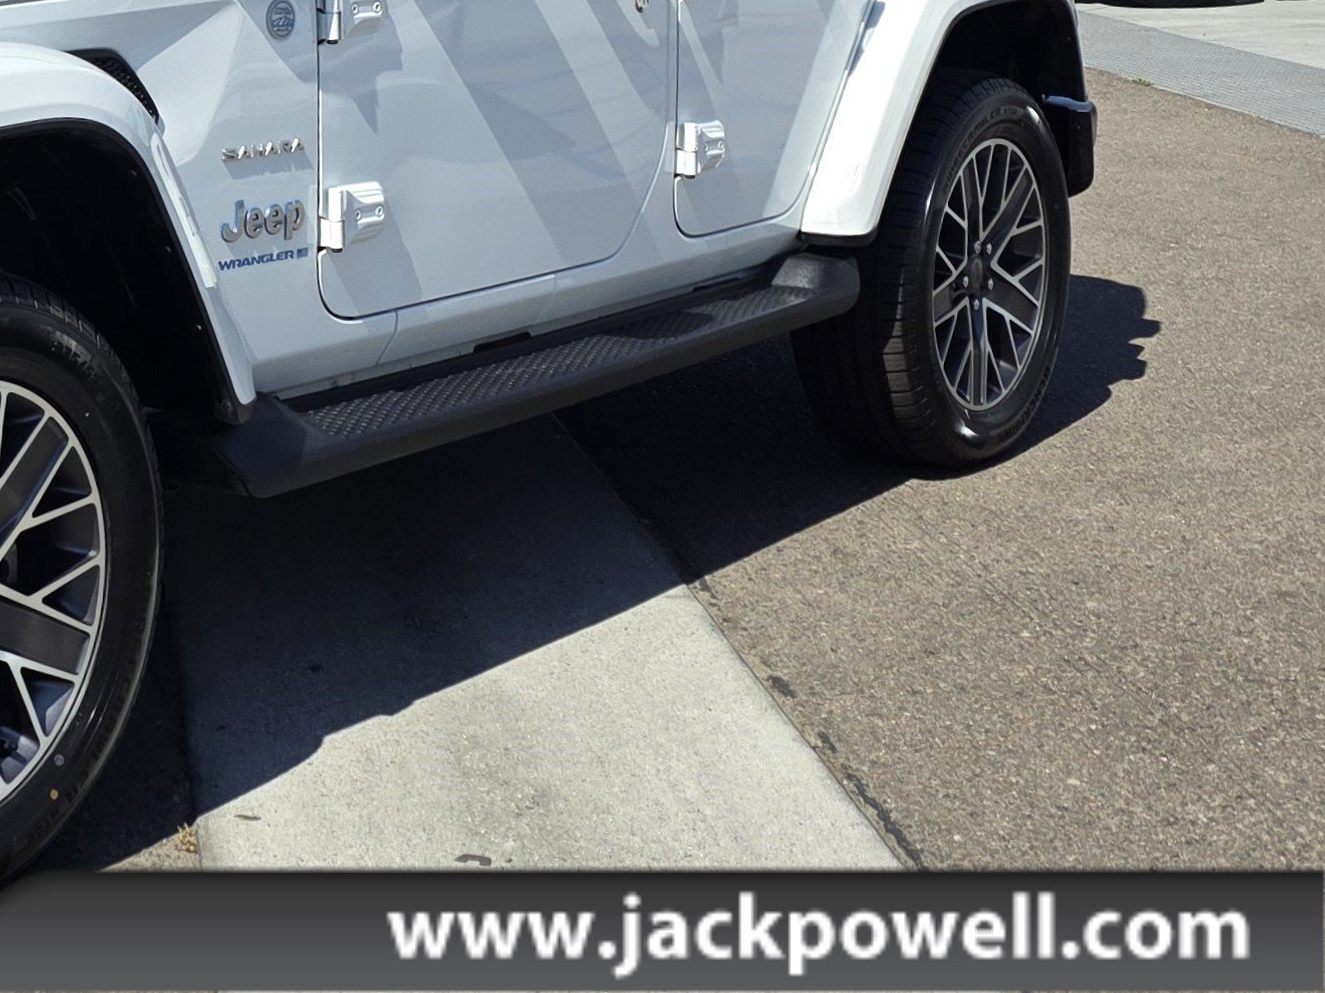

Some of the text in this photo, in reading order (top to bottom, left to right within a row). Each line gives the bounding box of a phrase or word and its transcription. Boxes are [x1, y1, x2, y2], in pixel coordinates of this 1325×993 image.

[221, 137, 304, 162] SAHARA
[221, 199, 306, 243] Jeep
[218, 250, 294, 271] WRANGLER
